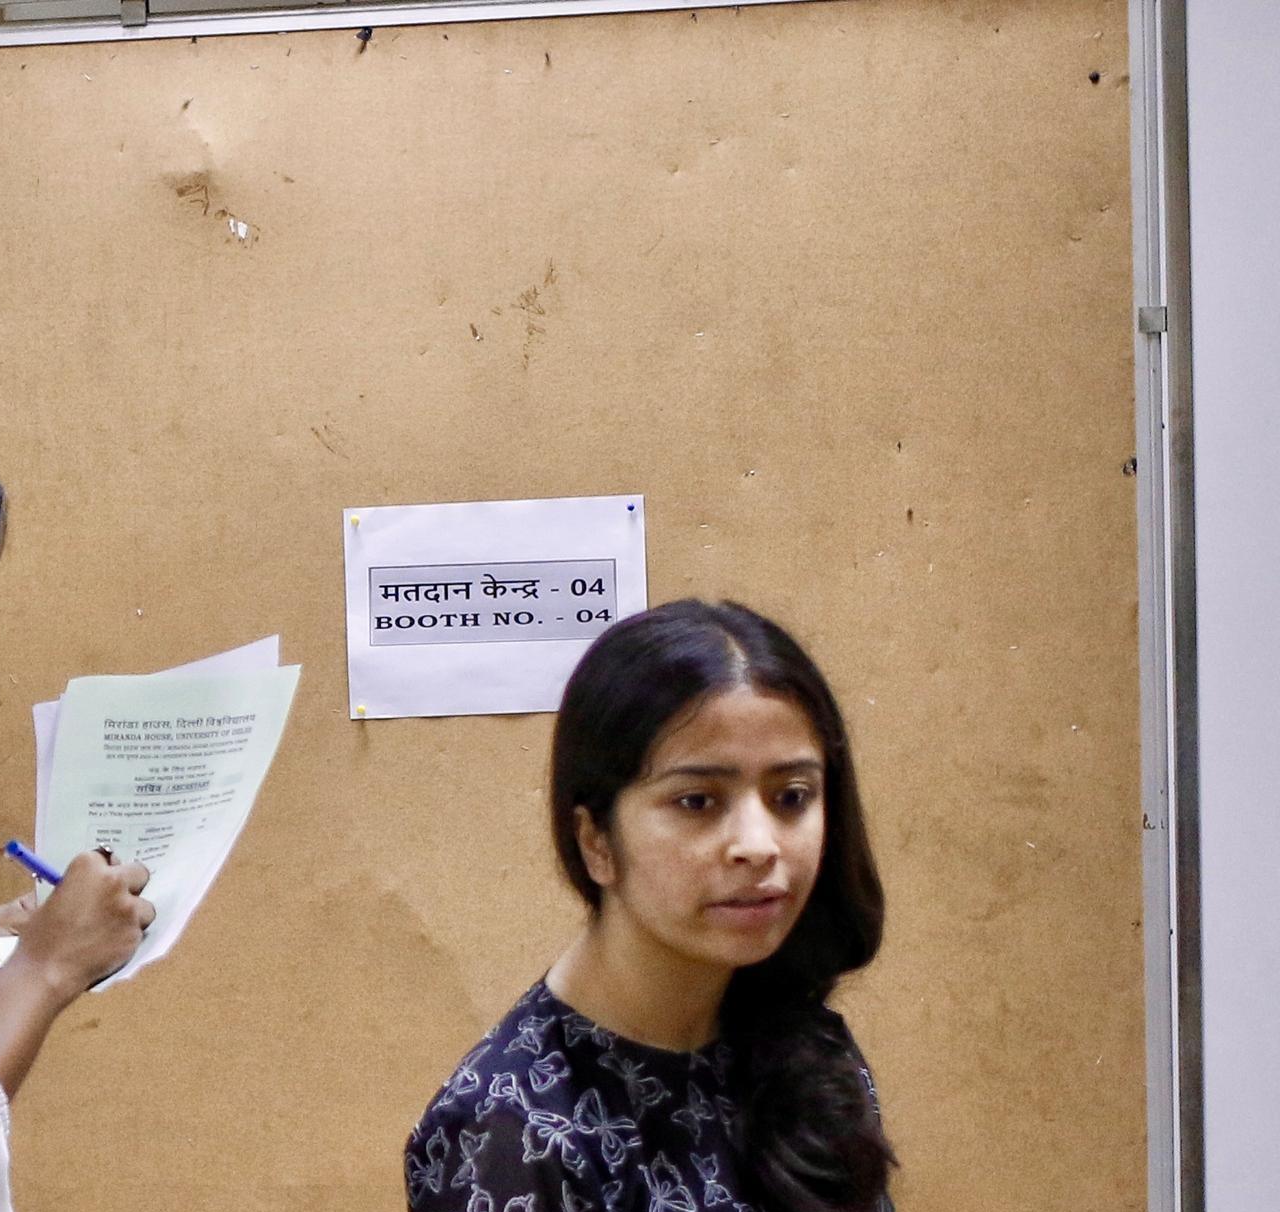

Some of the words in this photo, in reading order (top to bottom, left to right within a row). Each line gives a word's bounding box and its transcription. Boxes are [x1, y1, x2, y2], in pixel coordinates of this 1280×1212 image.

[379, 582, 473, 603] मतदान
[480, 574, 540, 600] केन्द्र
[570, 578, 606, 596] 04
[374, 612, 481, 630] BOOTH
[493, 611, 544, 626] NO.
[576, 608, 612, 623] 04
[104, 733, 141, 741] MIRANDA
[176, 731, 219, 740] UNIVERSITY
